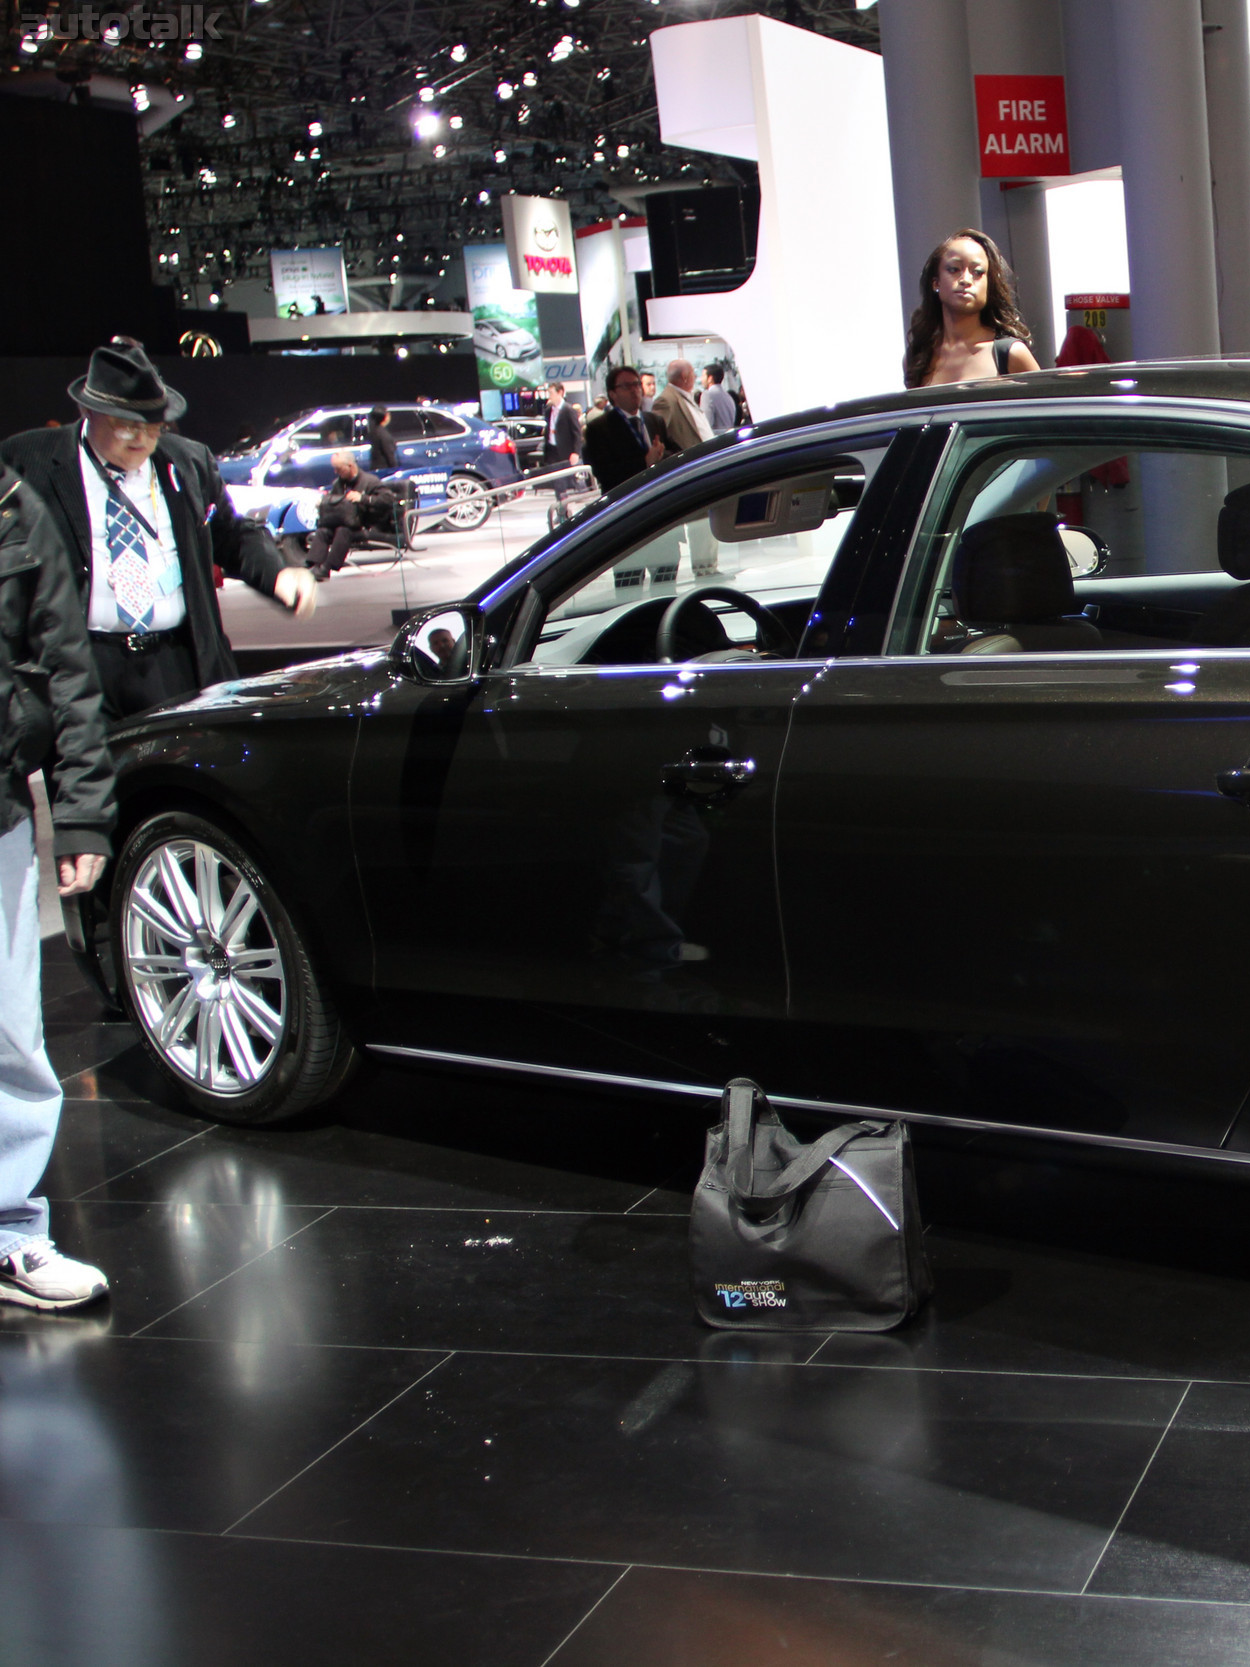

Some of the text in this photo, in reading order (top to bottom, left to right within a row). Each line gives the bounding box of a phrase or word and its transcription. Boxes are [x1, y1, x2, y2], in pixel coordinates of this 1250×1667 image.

[998, 99, 1047, 121] FIRE
[984, 133, 1064, 154] ALARM
[524, 254, 572, 275] TOYOTA
[1073, 296, 1094, 304] HOSE
[1095, 295, 1120, 304] VALVE
[1084, 310, 1106, 328] 209
[493, 365, 512, 380] 50
[543, 363, 577, 380] OU
[418, 484, 444, 494] TEAM
[752, 1299, 786, 1307] SHOW
